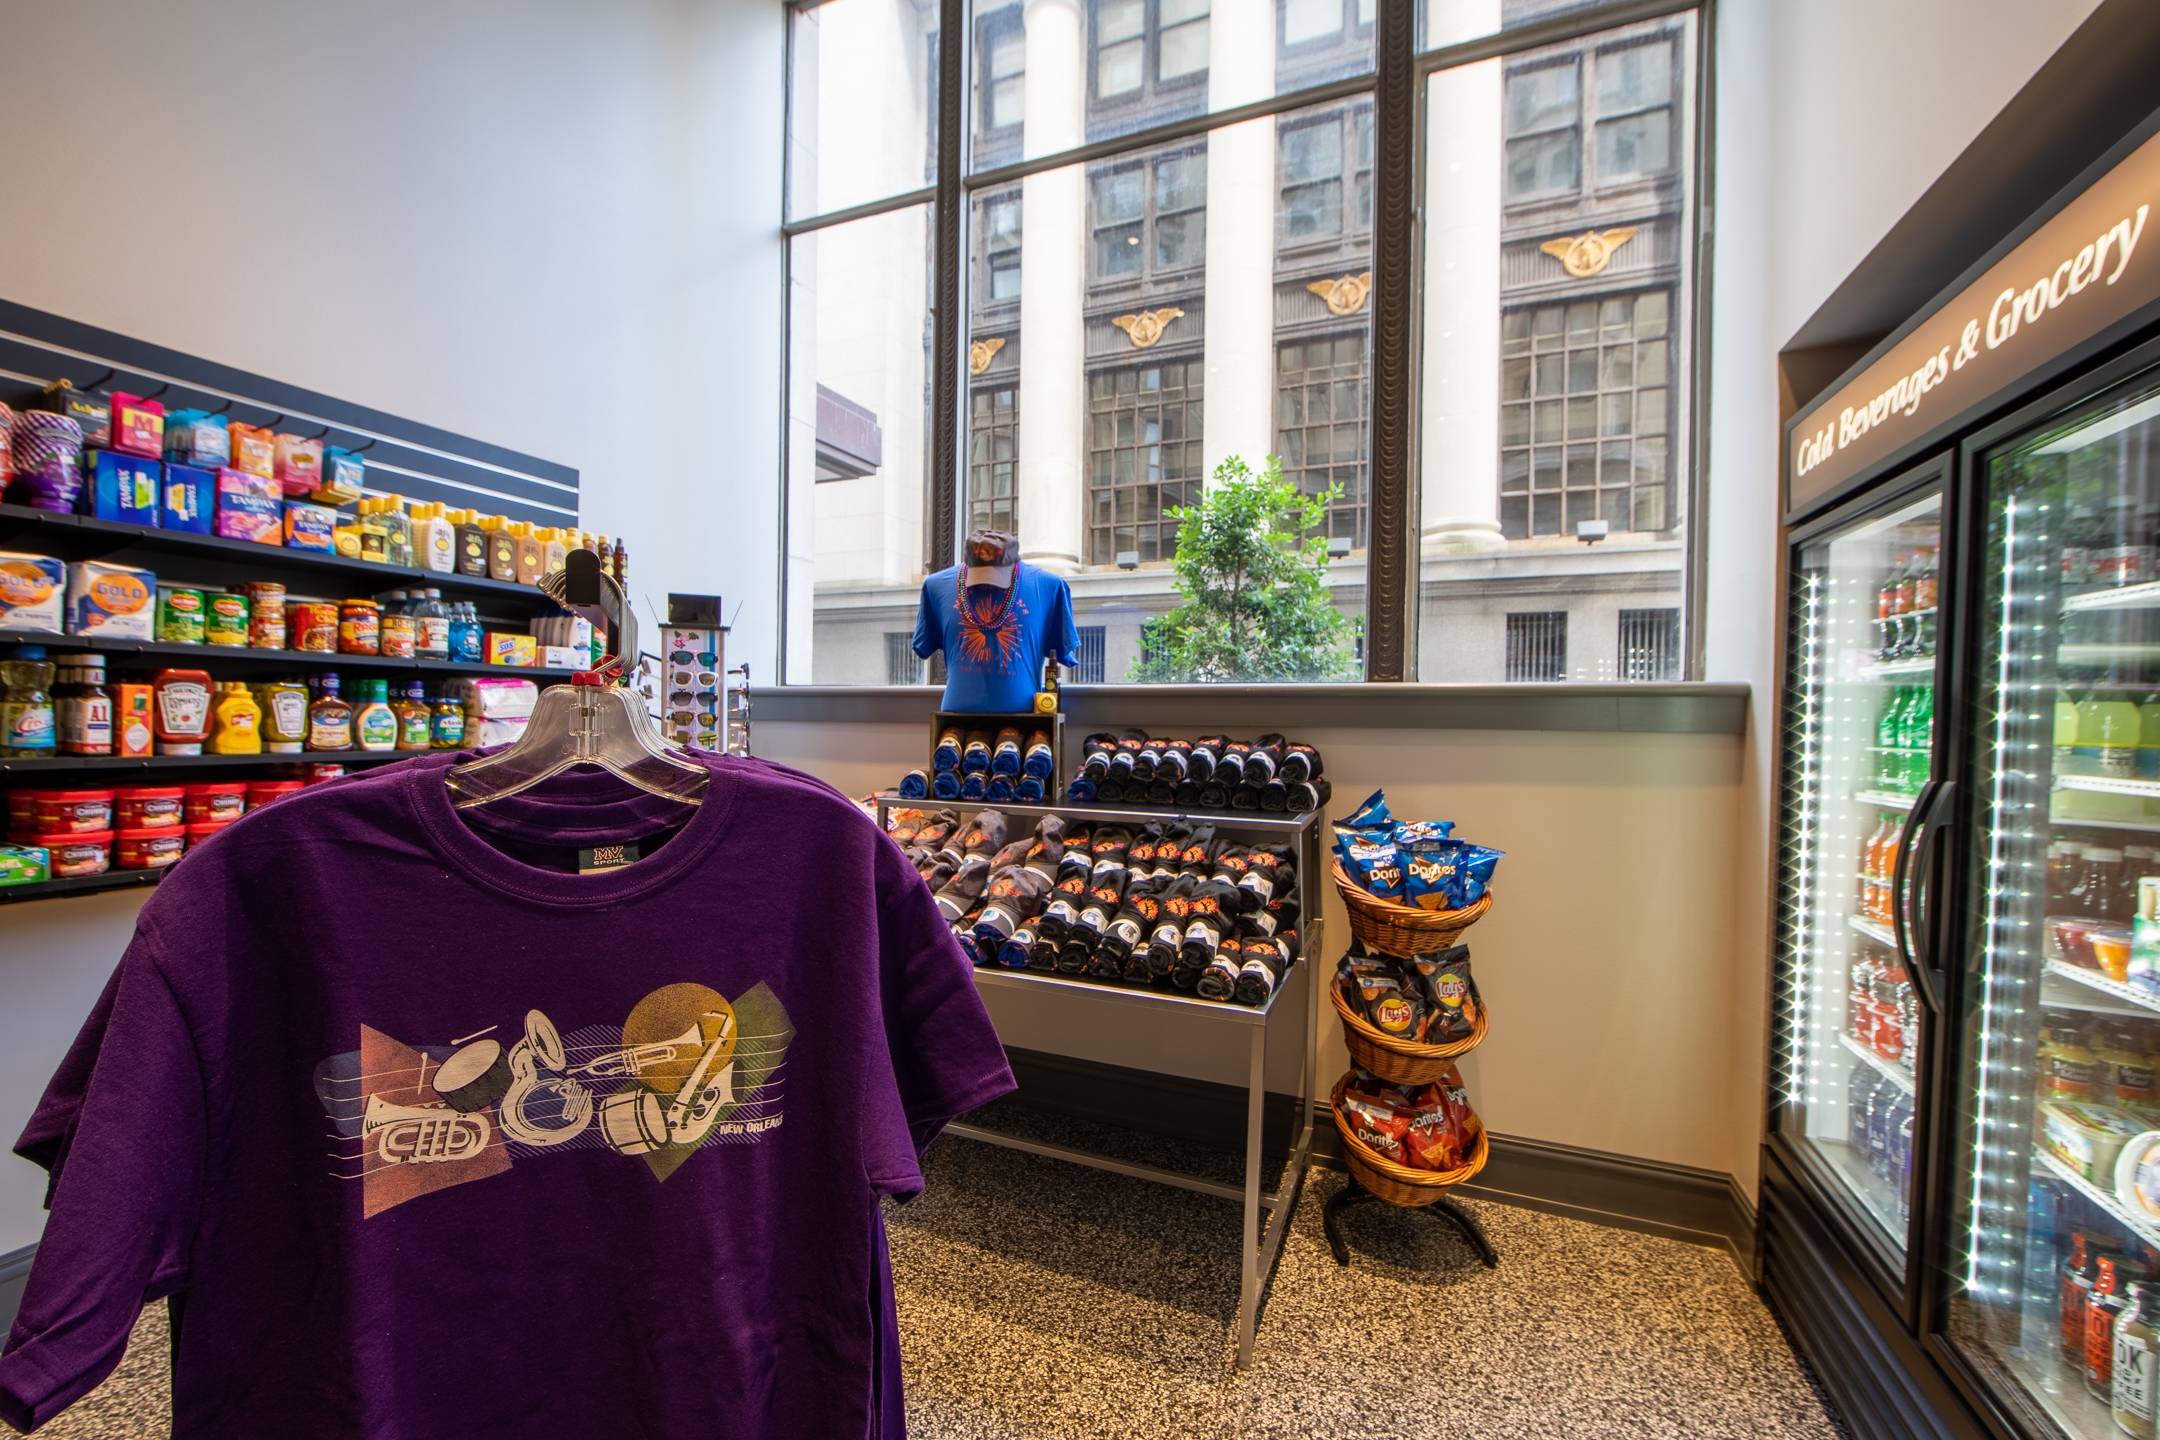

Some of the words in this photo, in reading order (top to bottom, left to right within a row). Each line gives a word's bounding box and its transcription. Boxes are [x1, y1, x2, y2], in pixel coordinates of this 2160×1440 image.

[1797, 422, 1834, 477] Cold
[1838, 345, 1950, 450] Beverages
[1953, 319, 1980, 372] &
[1986, 204, 2149, 350] Grocery
[117, 469, 133, 509] TAMPAX
[230, 494, 276, 509] TAMPAX
[97, 582, 143, 599] GOLD
[146, 804, 177, 812] CHUNKY
[594, 846, 623, 860] MV
[594, 858, 625, 866] SPORT
[1369, 867, 1400, 881] Dorit
[1408, 863, 1456, 877] Doritos
[720, 1123, 743, 1135] NEW
[746, 1115, 783, 1133] ORLEANS
